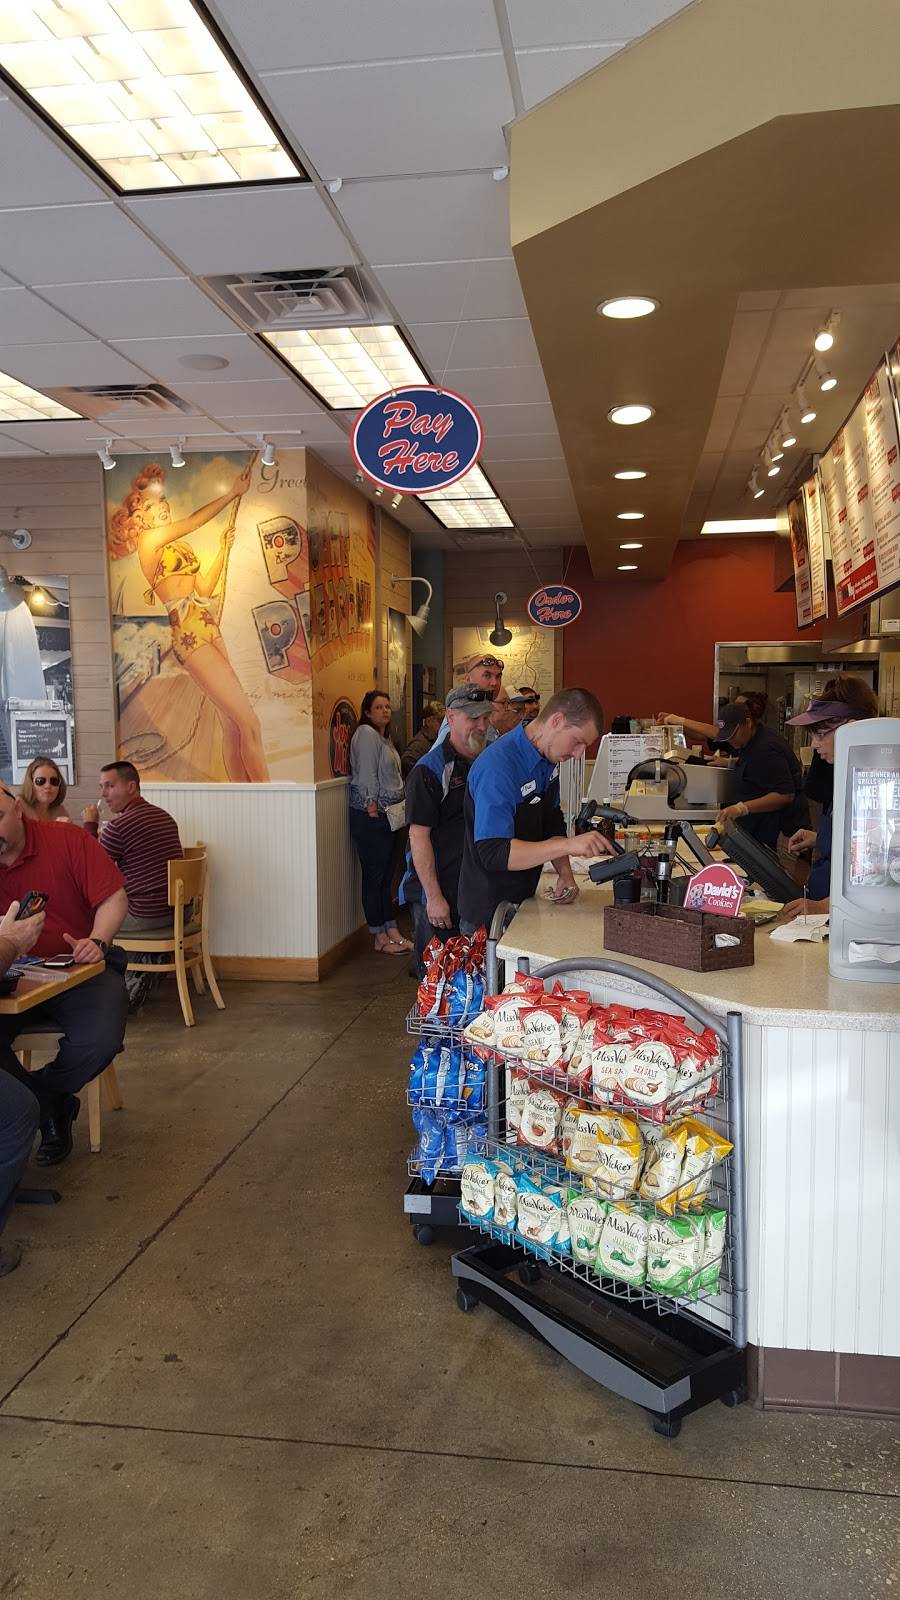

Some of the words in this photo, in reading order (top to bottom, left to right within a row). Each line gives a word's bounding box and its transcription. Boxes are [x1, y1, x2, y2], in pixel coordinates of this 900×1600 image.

[383, 400, 454, 443] Pay
[378, 439, 460, 475] Here
[535, 591, 575, 607] Order
[536, 606, 573, 622] Here
[703, 882, 740, 899] David's
[708, 896, 734, 908] Cookies
[600, 1066, 612, 1075] SEA
